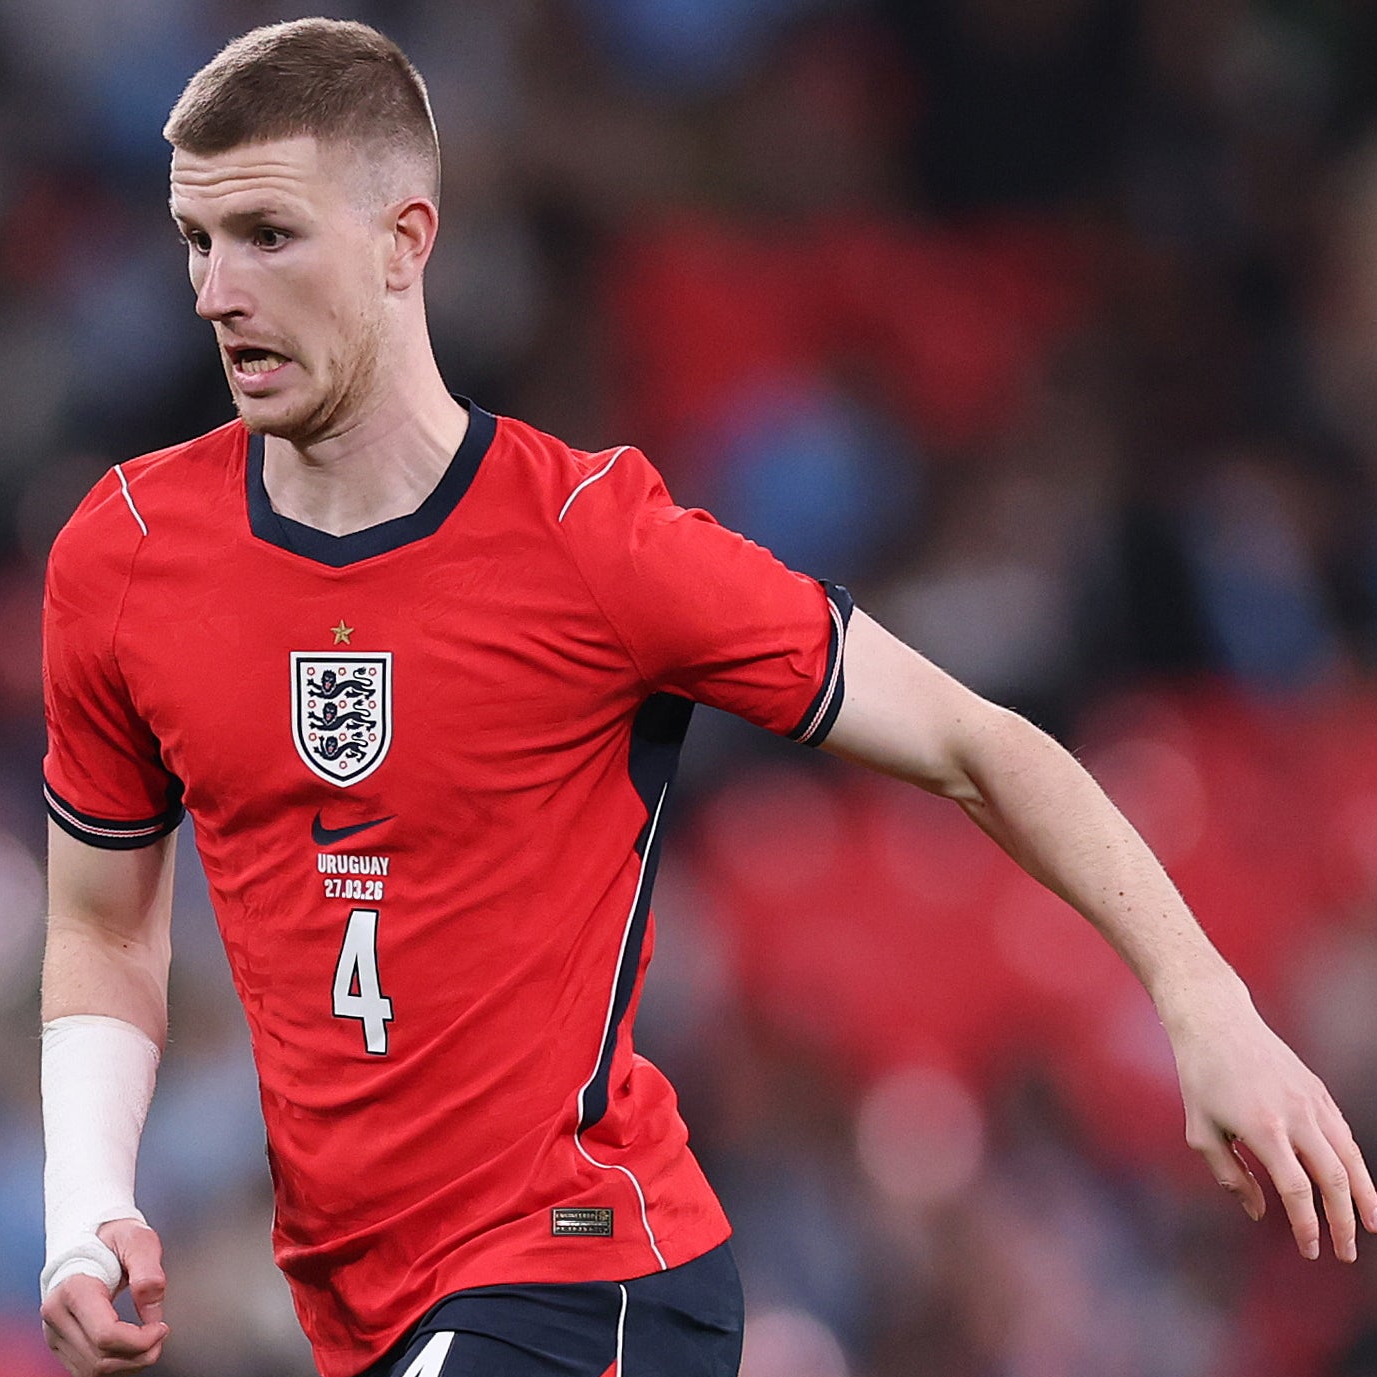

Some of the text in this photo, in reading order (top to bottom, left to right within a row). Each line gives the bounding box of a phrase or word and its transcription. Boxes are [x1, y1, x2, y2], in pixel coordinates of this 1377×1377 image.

[317, 853, 390, 876] URUGUAY
[324, 878, 383, 901] 27.03.26
[331, 908, 394, 1055] 4
